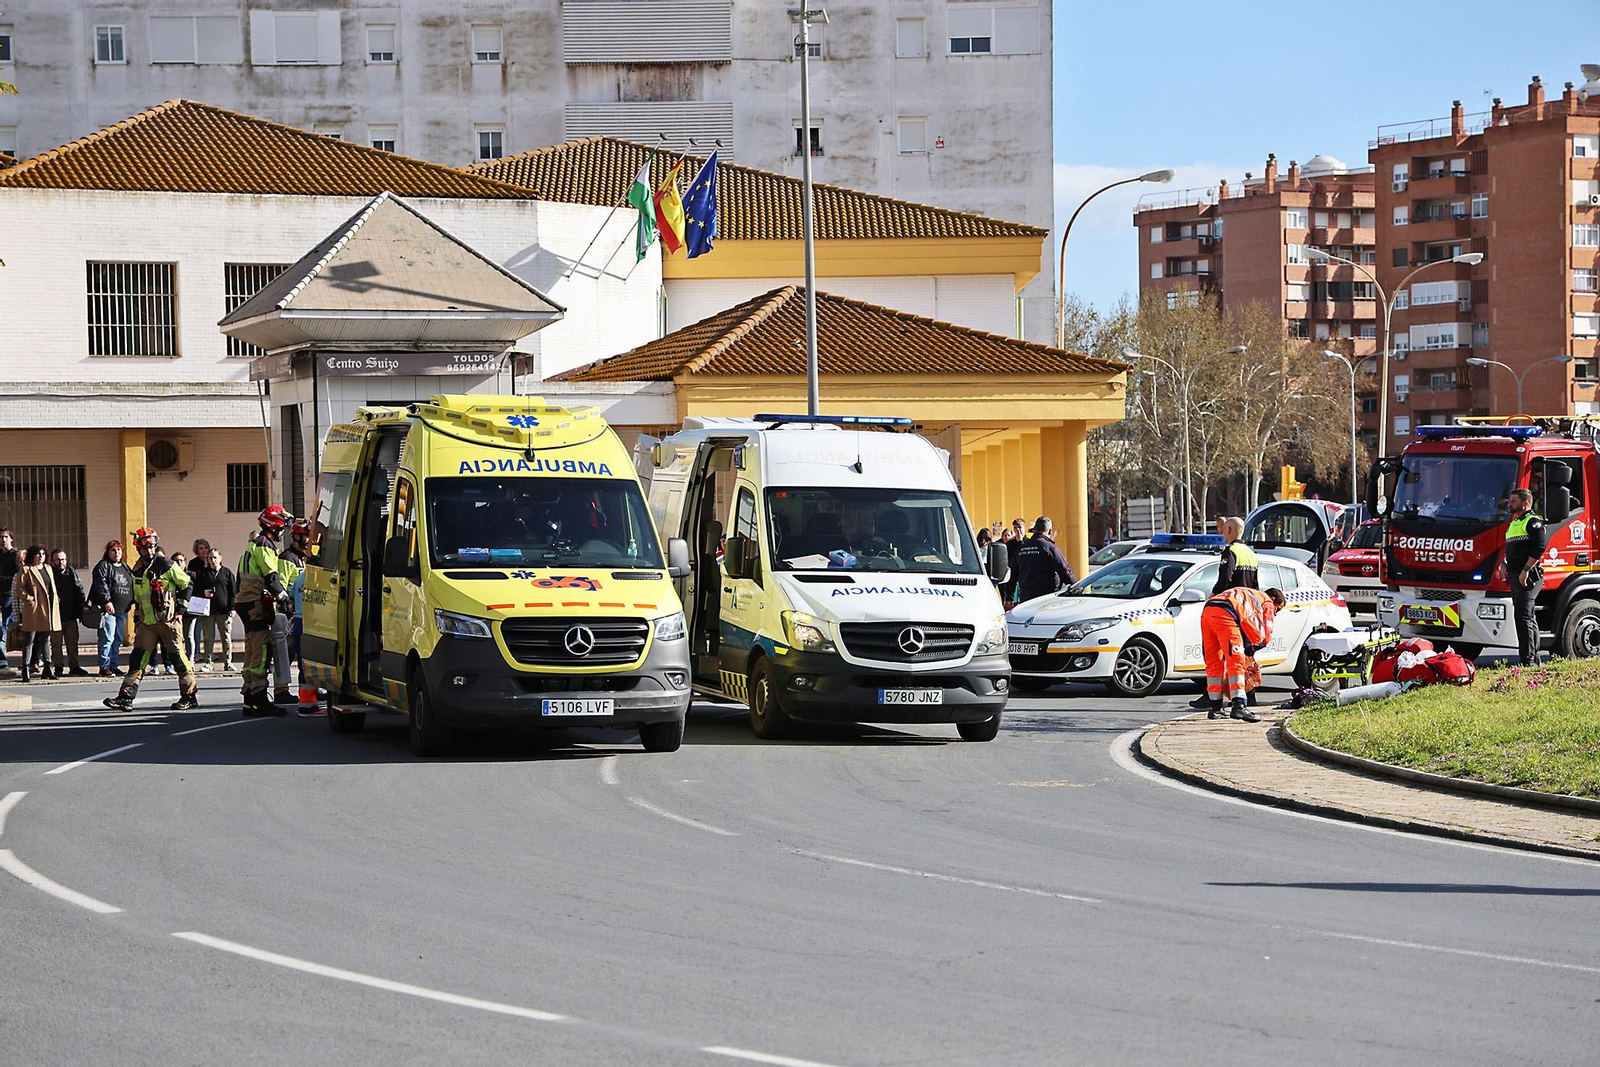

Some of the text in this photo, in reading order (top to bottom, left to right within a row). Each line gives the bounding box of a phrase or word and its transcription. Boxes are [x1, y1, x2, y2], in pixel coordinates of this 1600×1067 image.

[326, 356, 399, 371] Centro Suizo
[453, 354, 495, 363] TOLDOS
[1414, 550, 1455, 563] IVECO
[1023, 644, 1036, 654] HVF
[885, 691, 940, 703] 5780 JNZ
[551, 701, 610, 713] 5106 LVF
